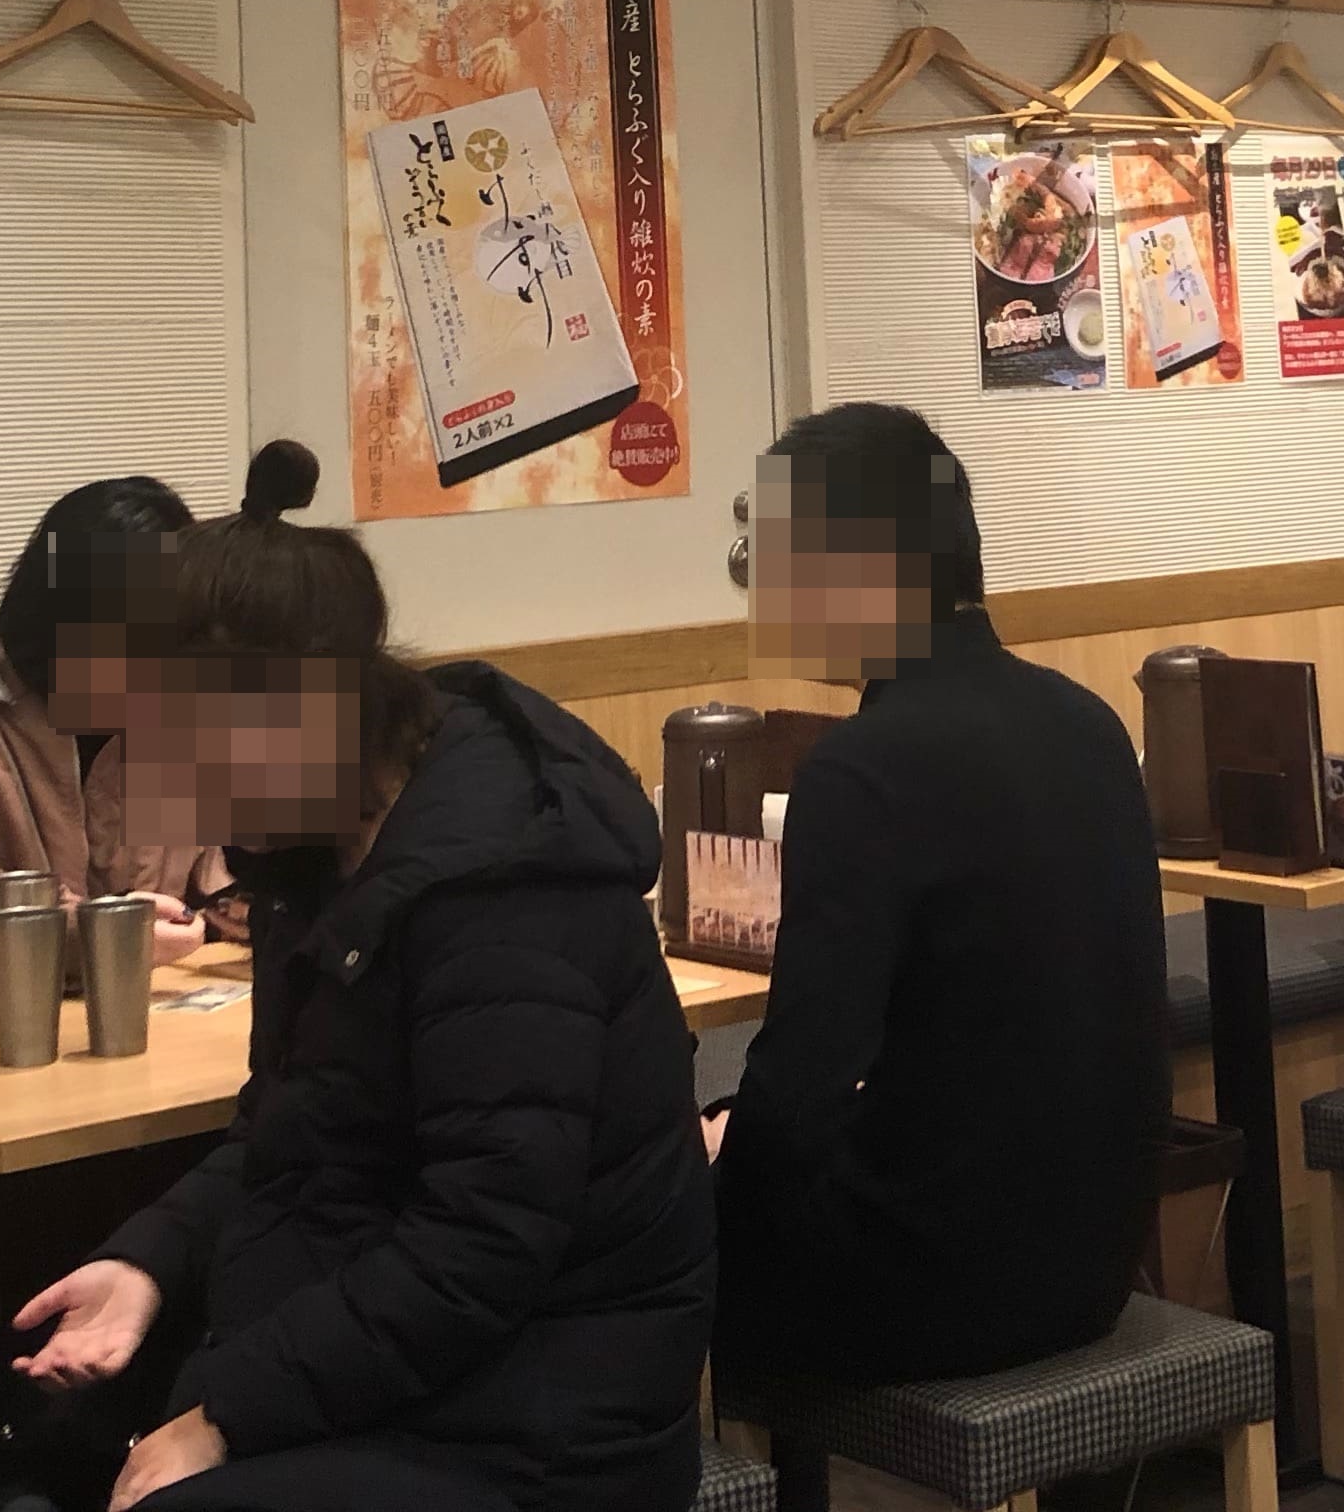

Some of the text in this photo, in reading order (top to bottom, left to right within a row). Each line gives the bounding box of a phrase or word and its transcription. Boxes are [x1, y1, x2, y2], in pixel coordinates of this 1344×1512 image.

[625, 51, 657, 336] とらふぐ入り雑炊の素
